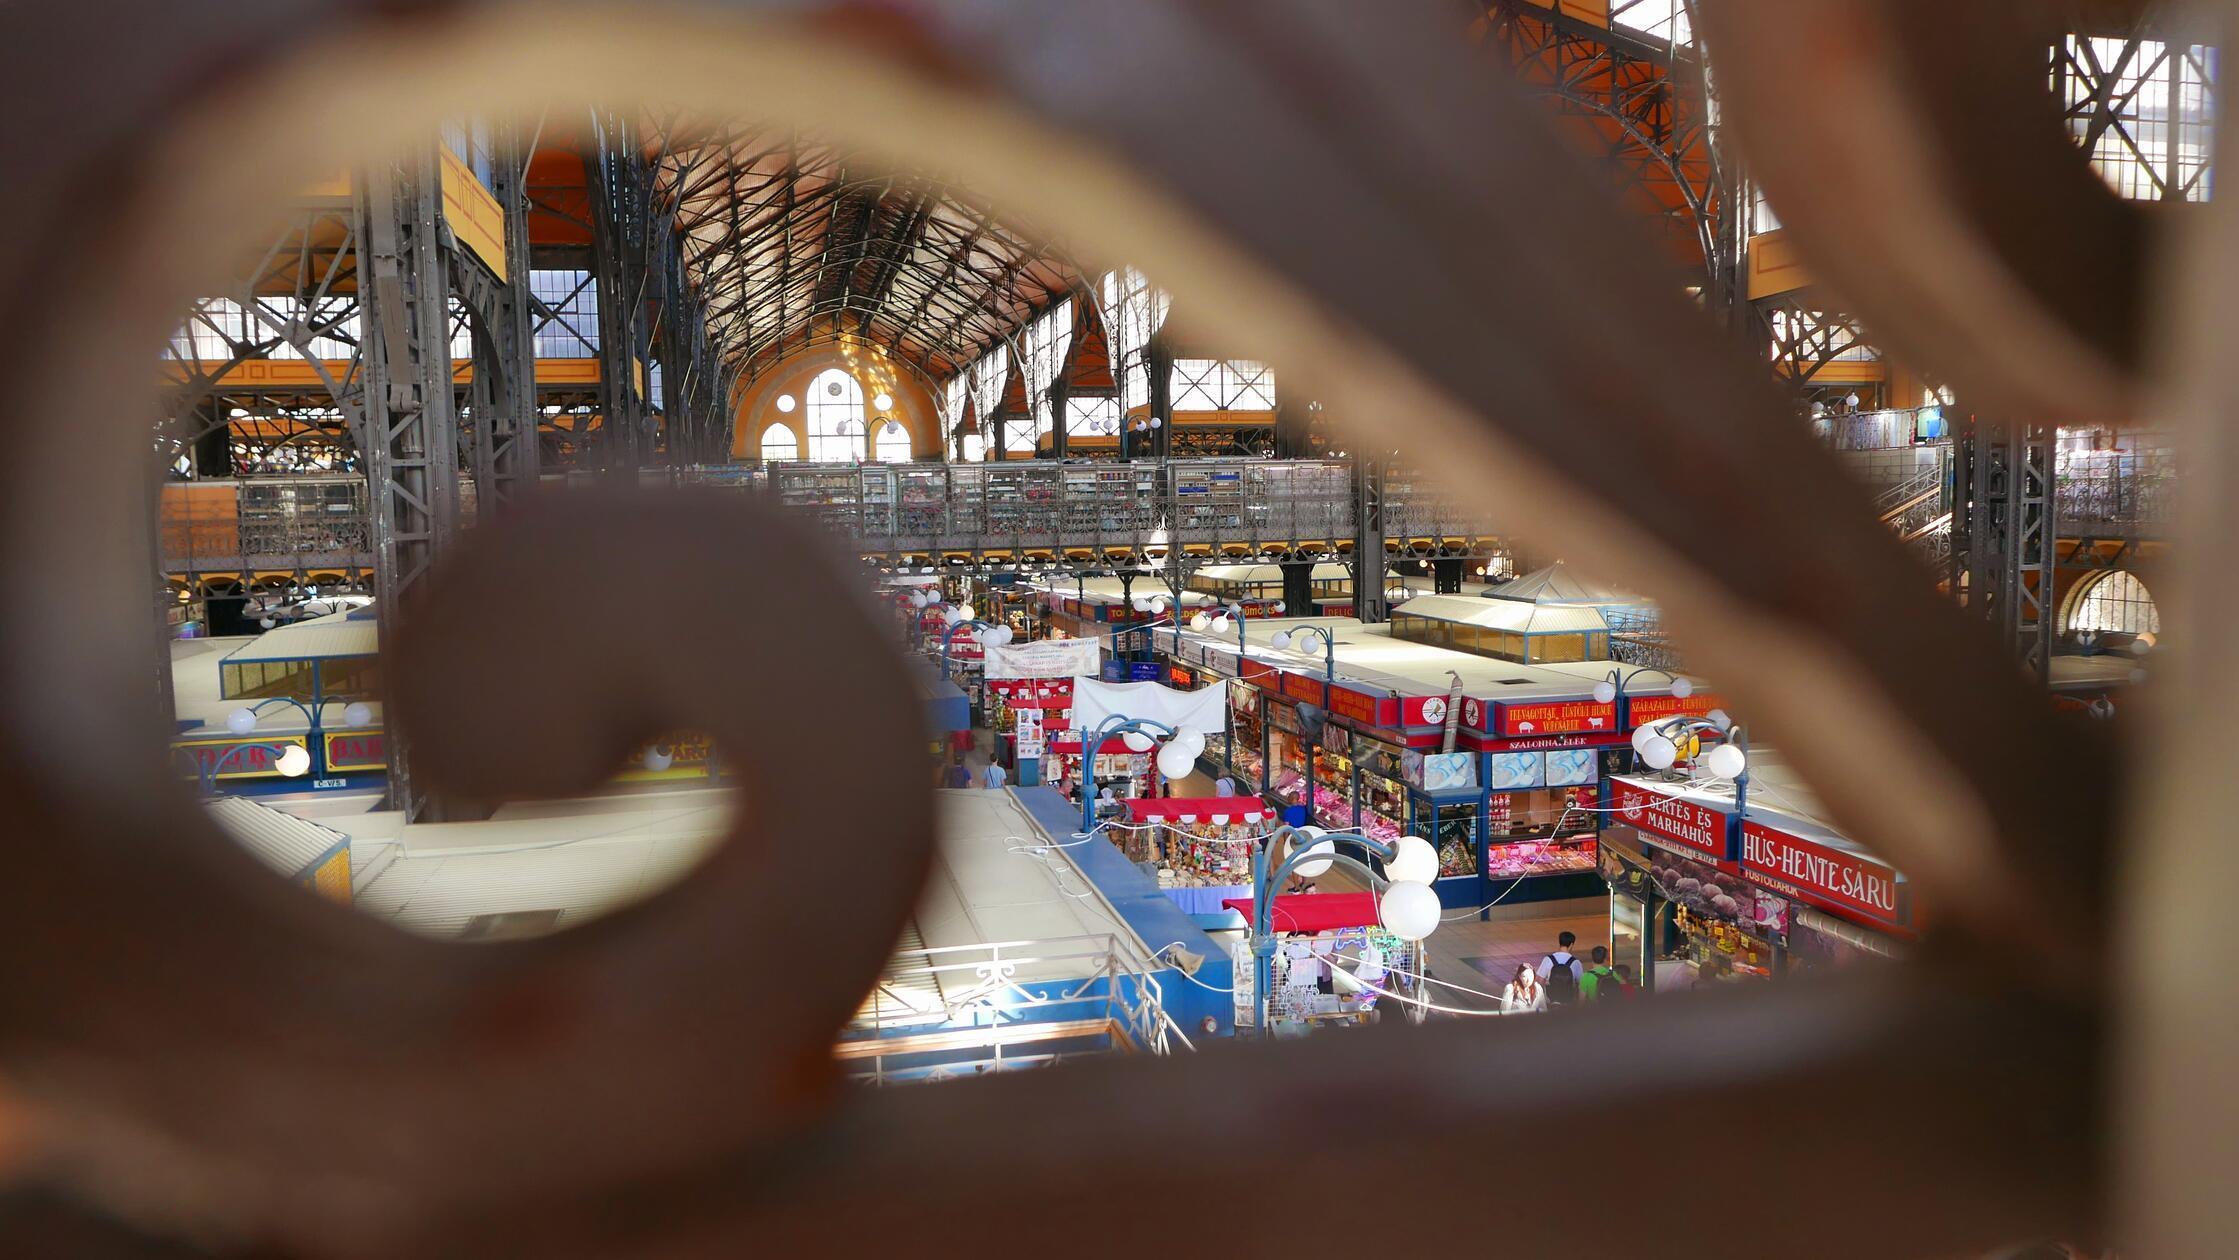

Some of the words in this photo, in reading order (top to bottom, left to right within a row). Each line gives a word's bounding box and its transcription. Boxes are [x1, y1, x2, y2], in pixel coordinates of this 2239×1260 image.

[1649, 795, 1690, 821] SERTÉS
[1697, 808, 1712, 828] ÉS
[1647, 812, 1713, 847] MARHAHÚS
